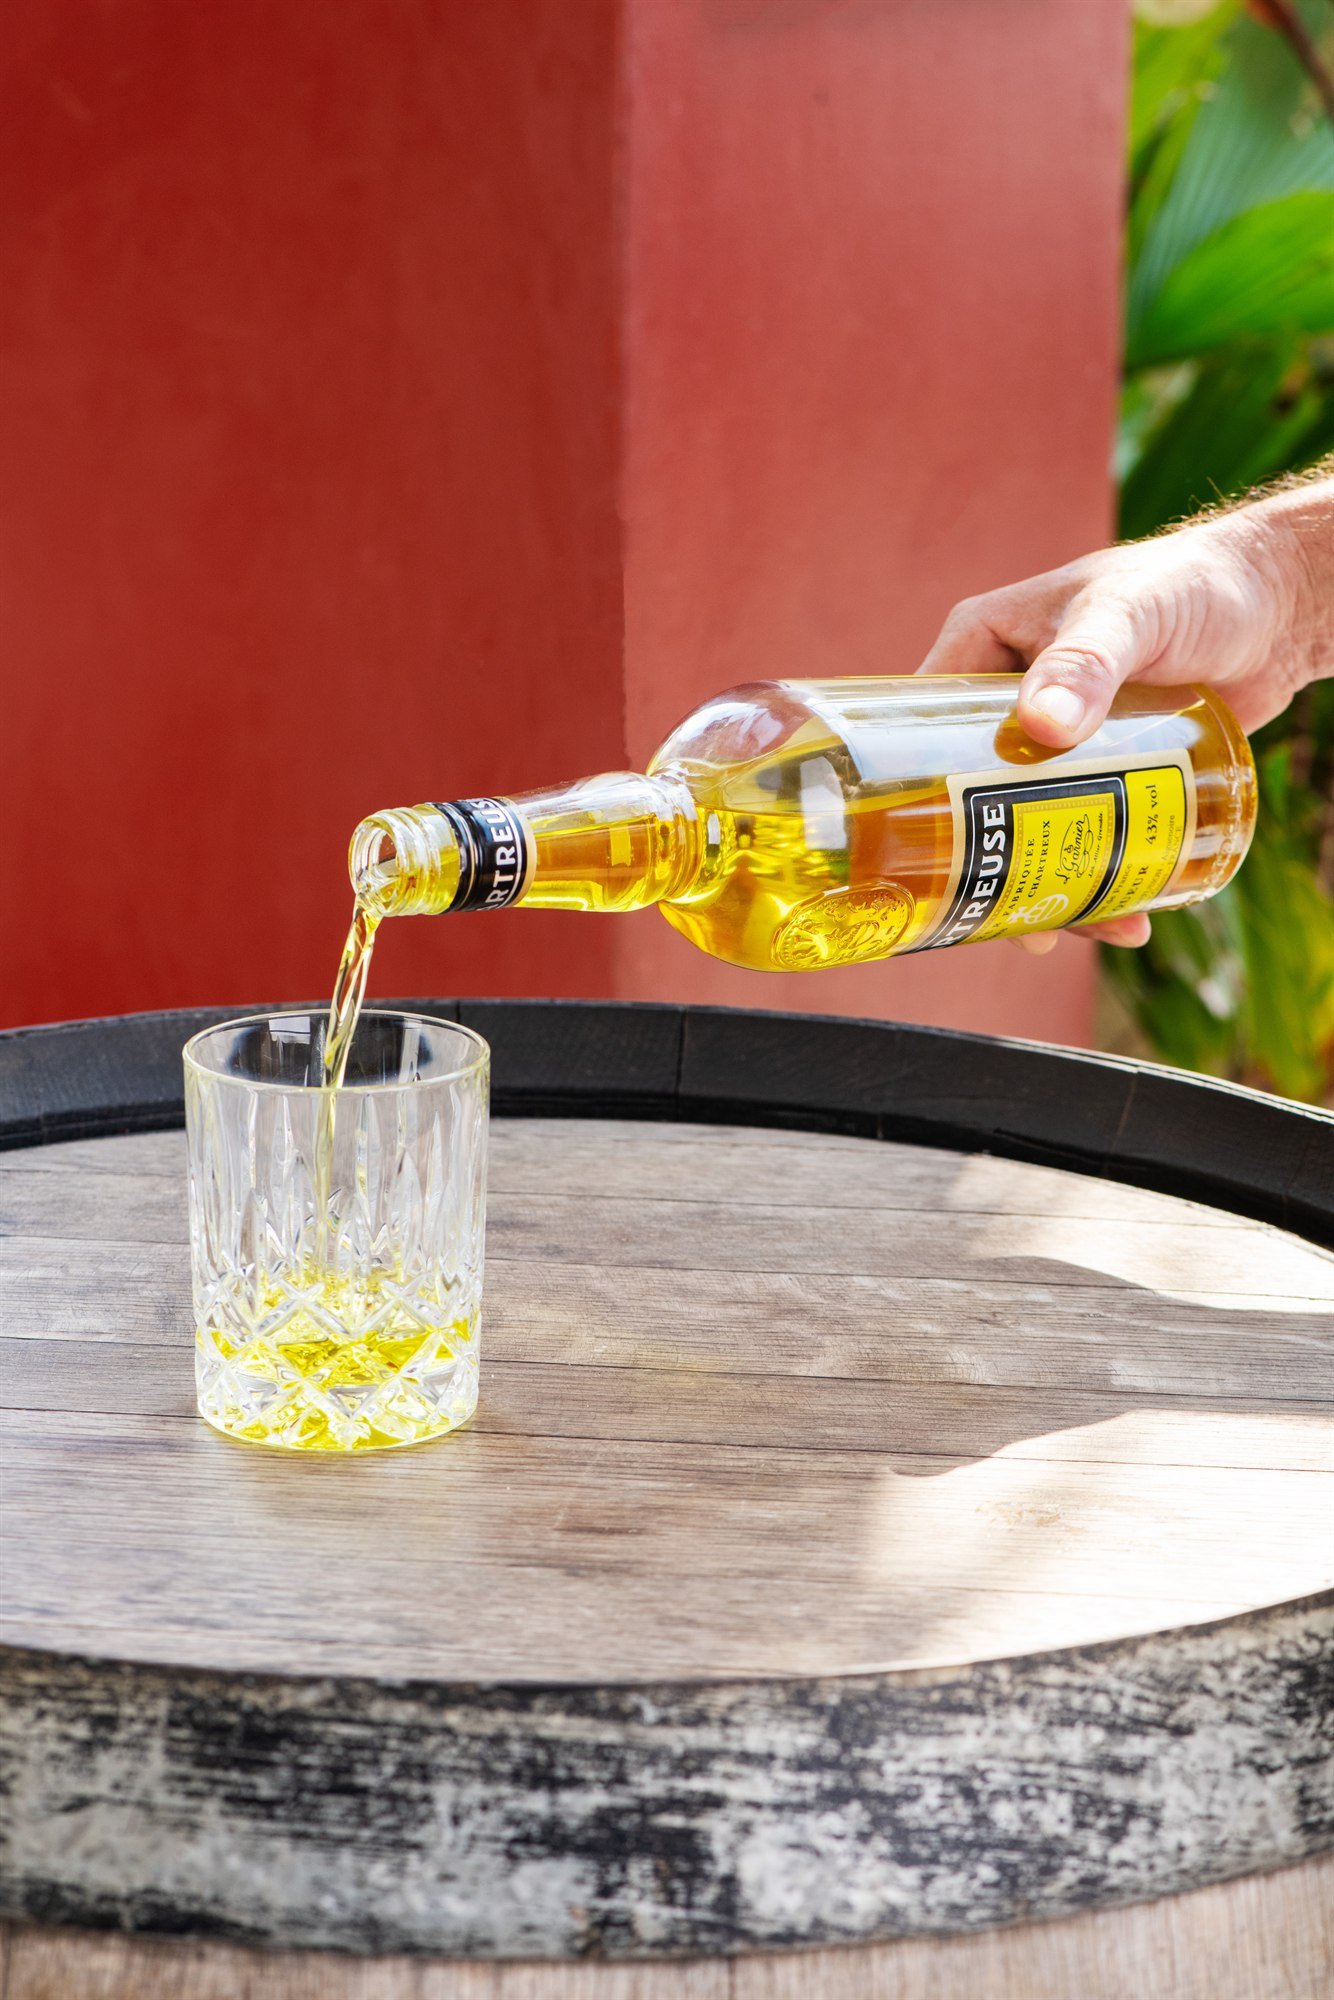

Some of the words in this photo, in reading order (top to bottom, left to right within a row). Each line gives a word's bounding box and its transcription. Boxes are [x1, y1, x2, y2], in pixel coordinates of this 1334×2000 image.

[1145, 783, 1159, 808] vol
[1144, 813, 1159, 845] 43%
[1002, 838, 1036, 916] FABRIQUÉE
[1027, 820, 1051, 898] CHARTREUX
